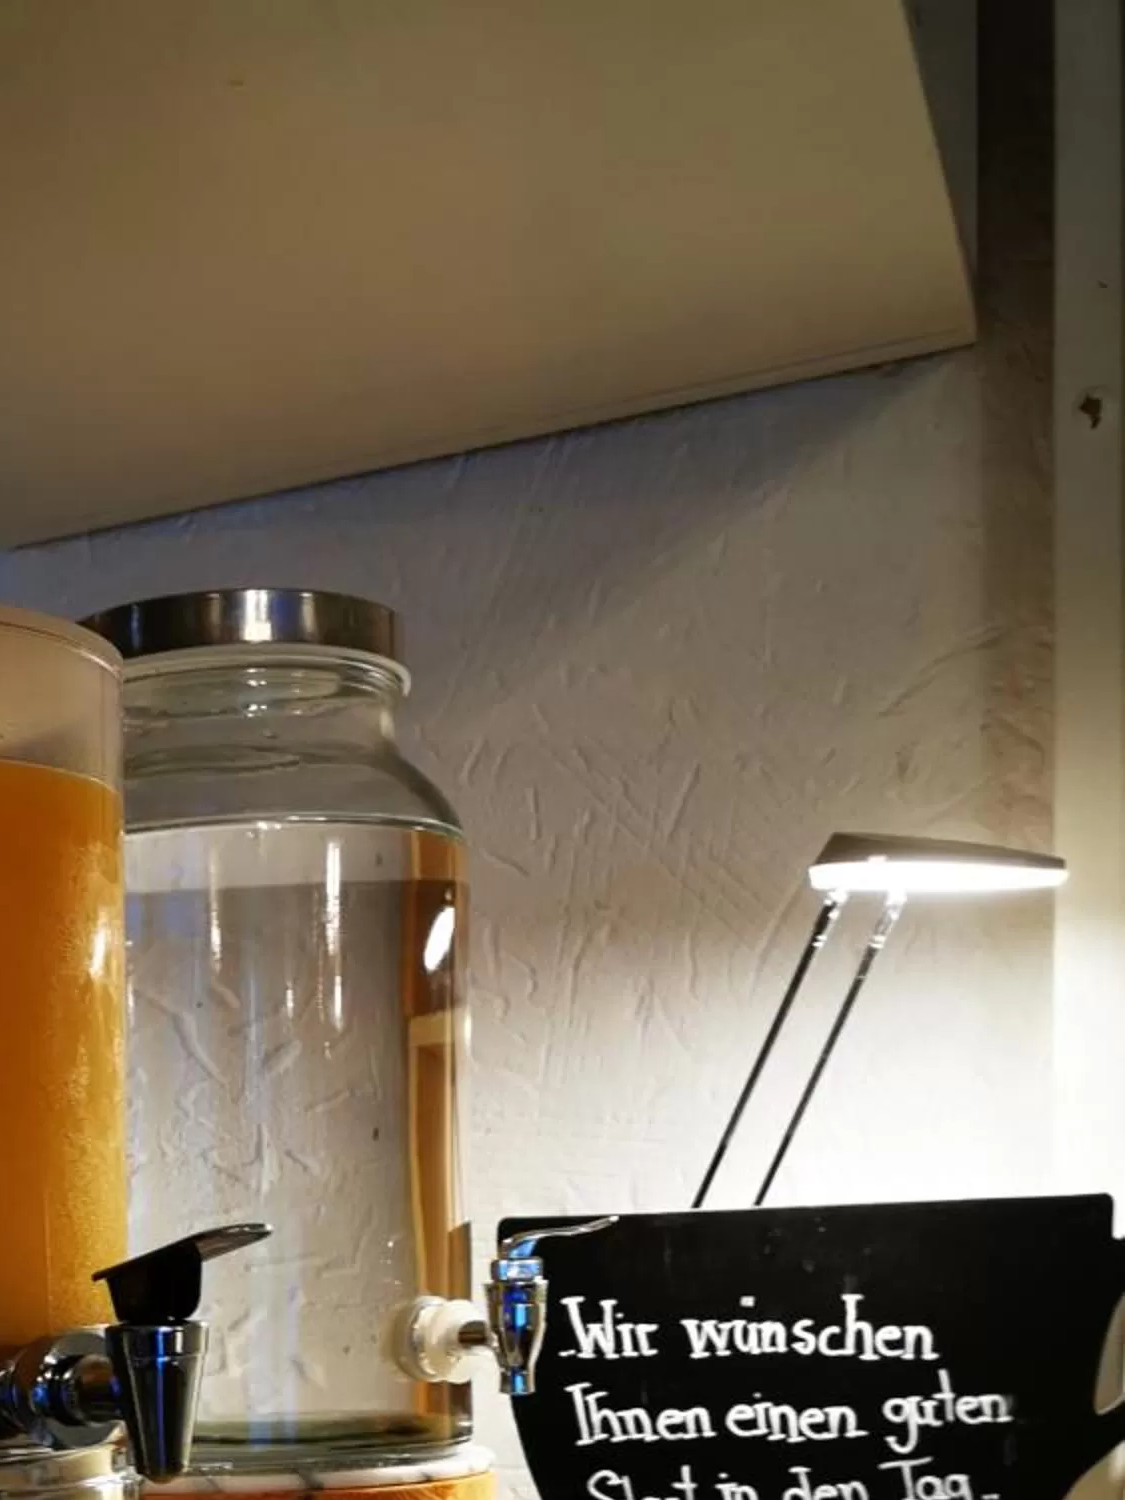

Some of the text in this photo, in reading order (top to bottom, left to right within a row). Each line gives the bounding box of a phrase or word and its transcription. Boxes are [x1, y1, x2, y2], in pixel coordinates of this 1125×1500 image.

[563, 1368, 1013, 1455] Ihnen einen guten
